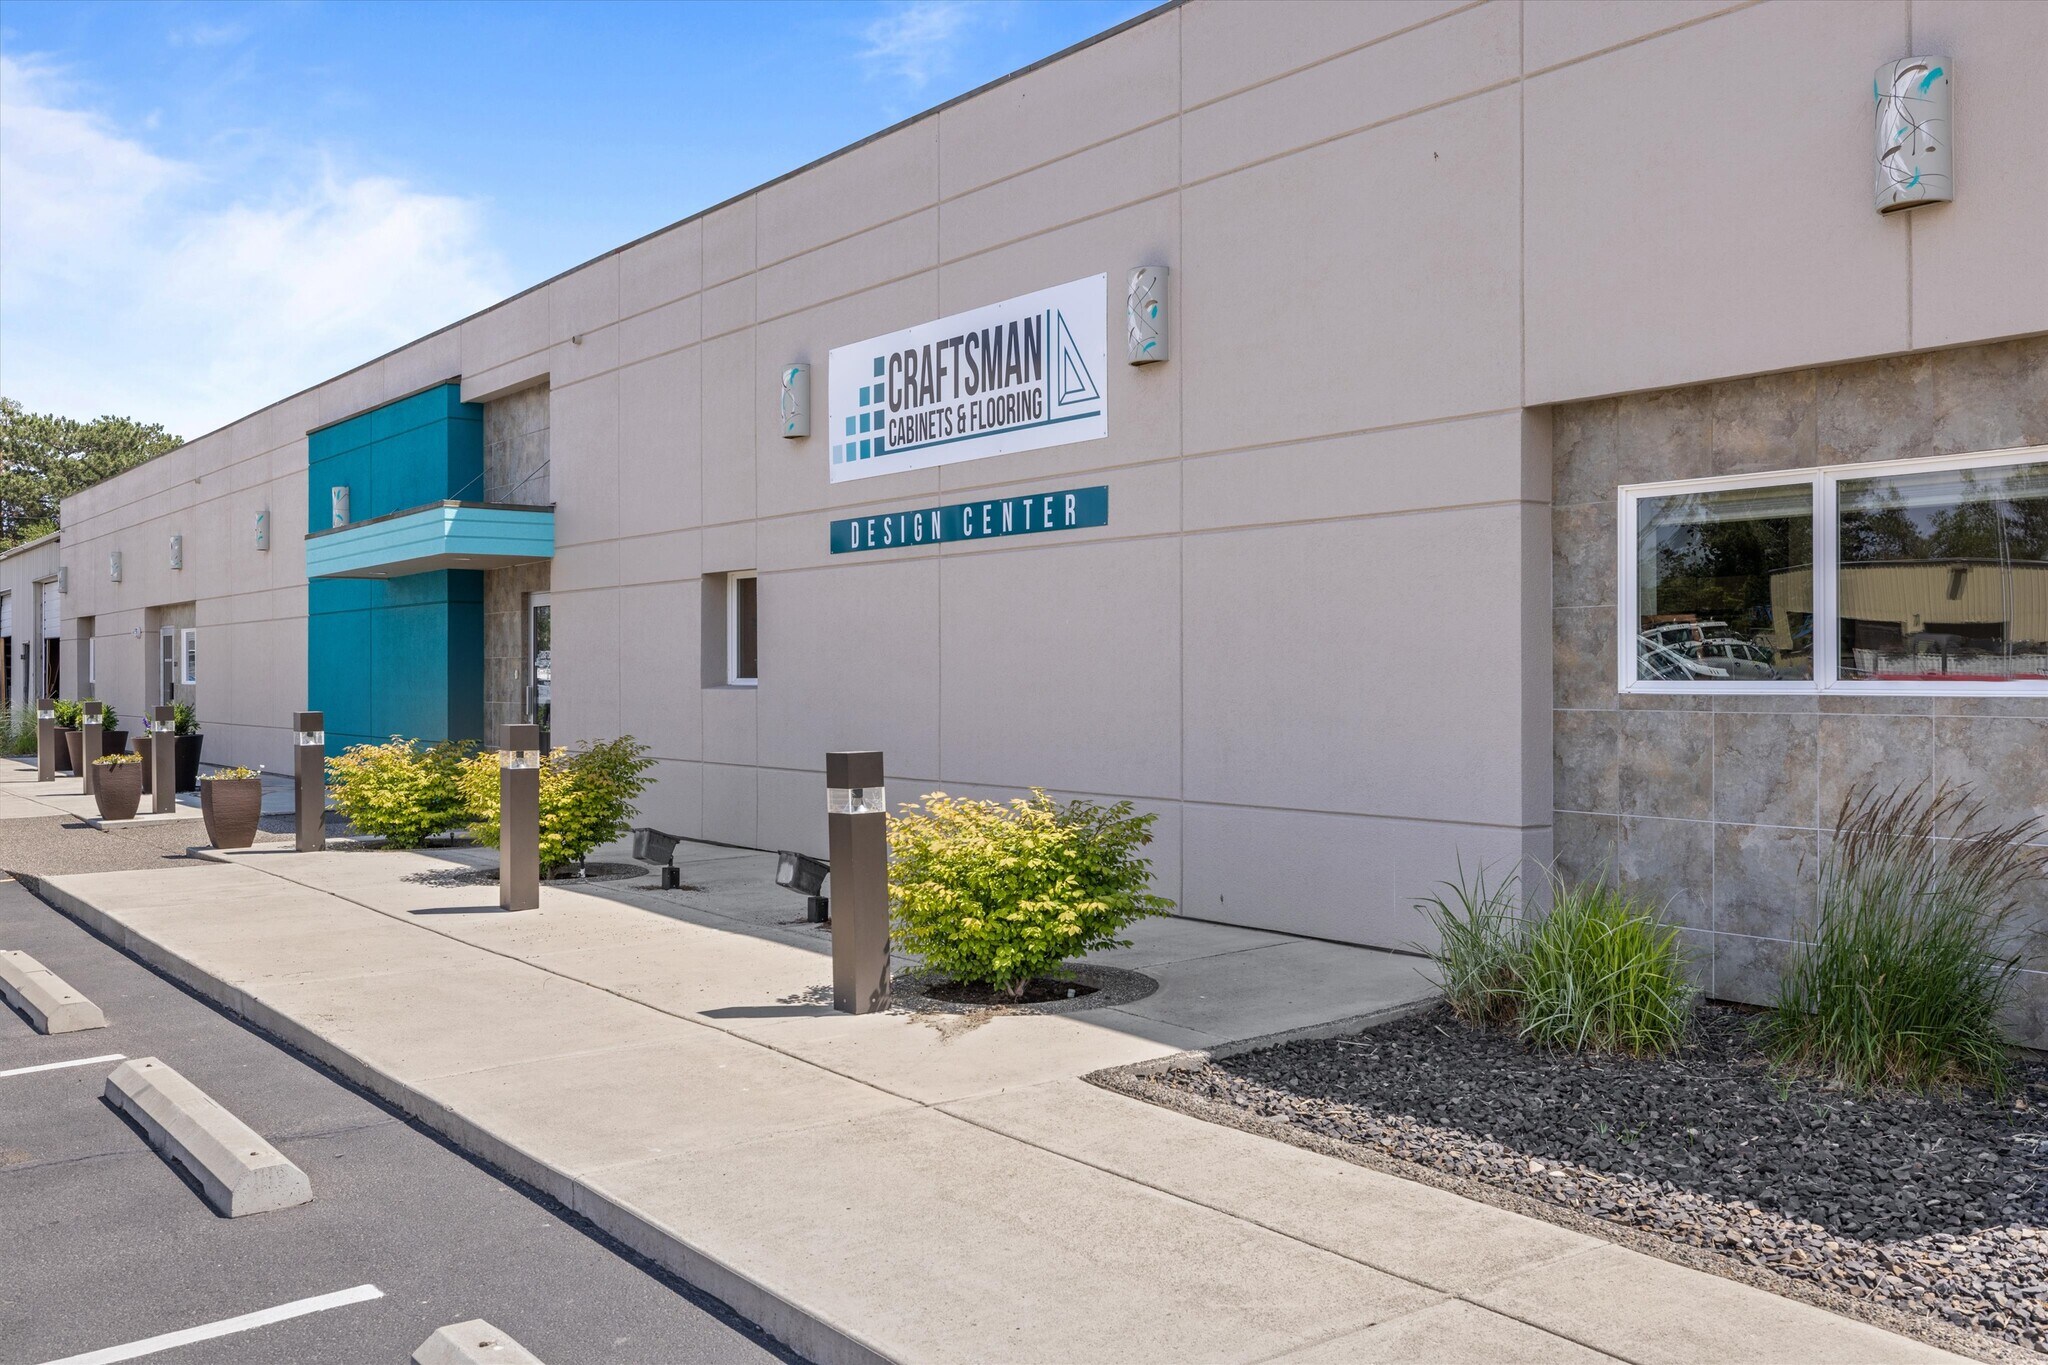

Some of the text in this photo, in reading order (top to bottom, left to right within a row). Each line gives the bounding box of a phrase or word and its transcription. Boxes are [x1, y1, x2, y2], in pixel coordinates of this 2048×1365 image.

[888, 314, 1042, 413] CRAFTSMAN
[888, 387, 1042, 447] CABINETS & FLOORING
[851, 494, 1076, 549] DESIGN CENTER
